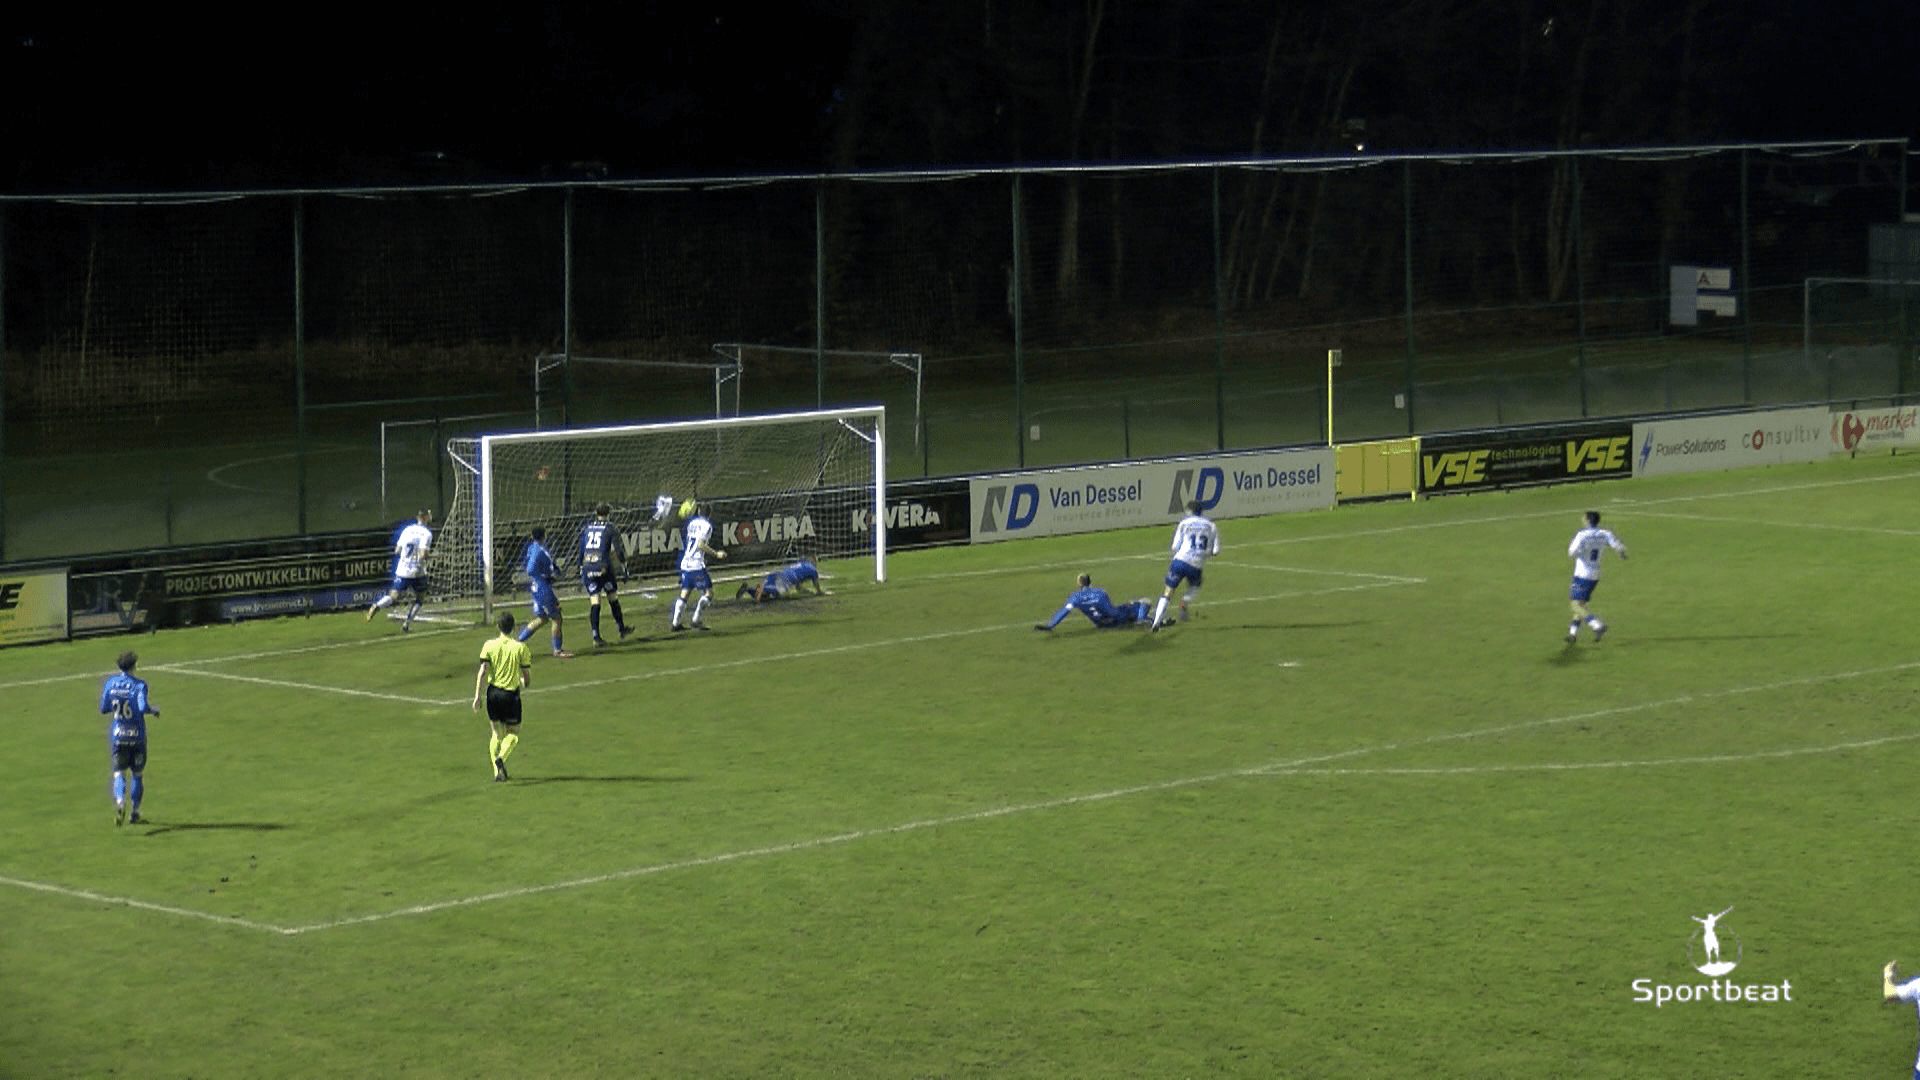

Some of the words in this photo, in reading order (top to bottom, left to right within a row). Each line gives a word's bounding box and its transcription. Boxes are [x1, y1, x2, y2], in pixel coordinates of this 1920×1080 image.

[1865, 408, 1917, 432] market
[1566, 436, 1631, 473] VSE
[1656, 438, 1727, 457] PowerSolutions
[1233, 471, 1263, 491] Van
[1267, 463, 1321, 488] Dessel
[1423, 450, 1490, 488] VSE
[1050, 487, 1081, 509] Van
[1086, 479, 1142, 507] Dessel
[586, 531, 602, 549] 25
[1191, 535, 1209, 551] 13
[166, 565, 330, 595] PROJECTONTWIKKELING
[112, 698, 133, 719] 26
